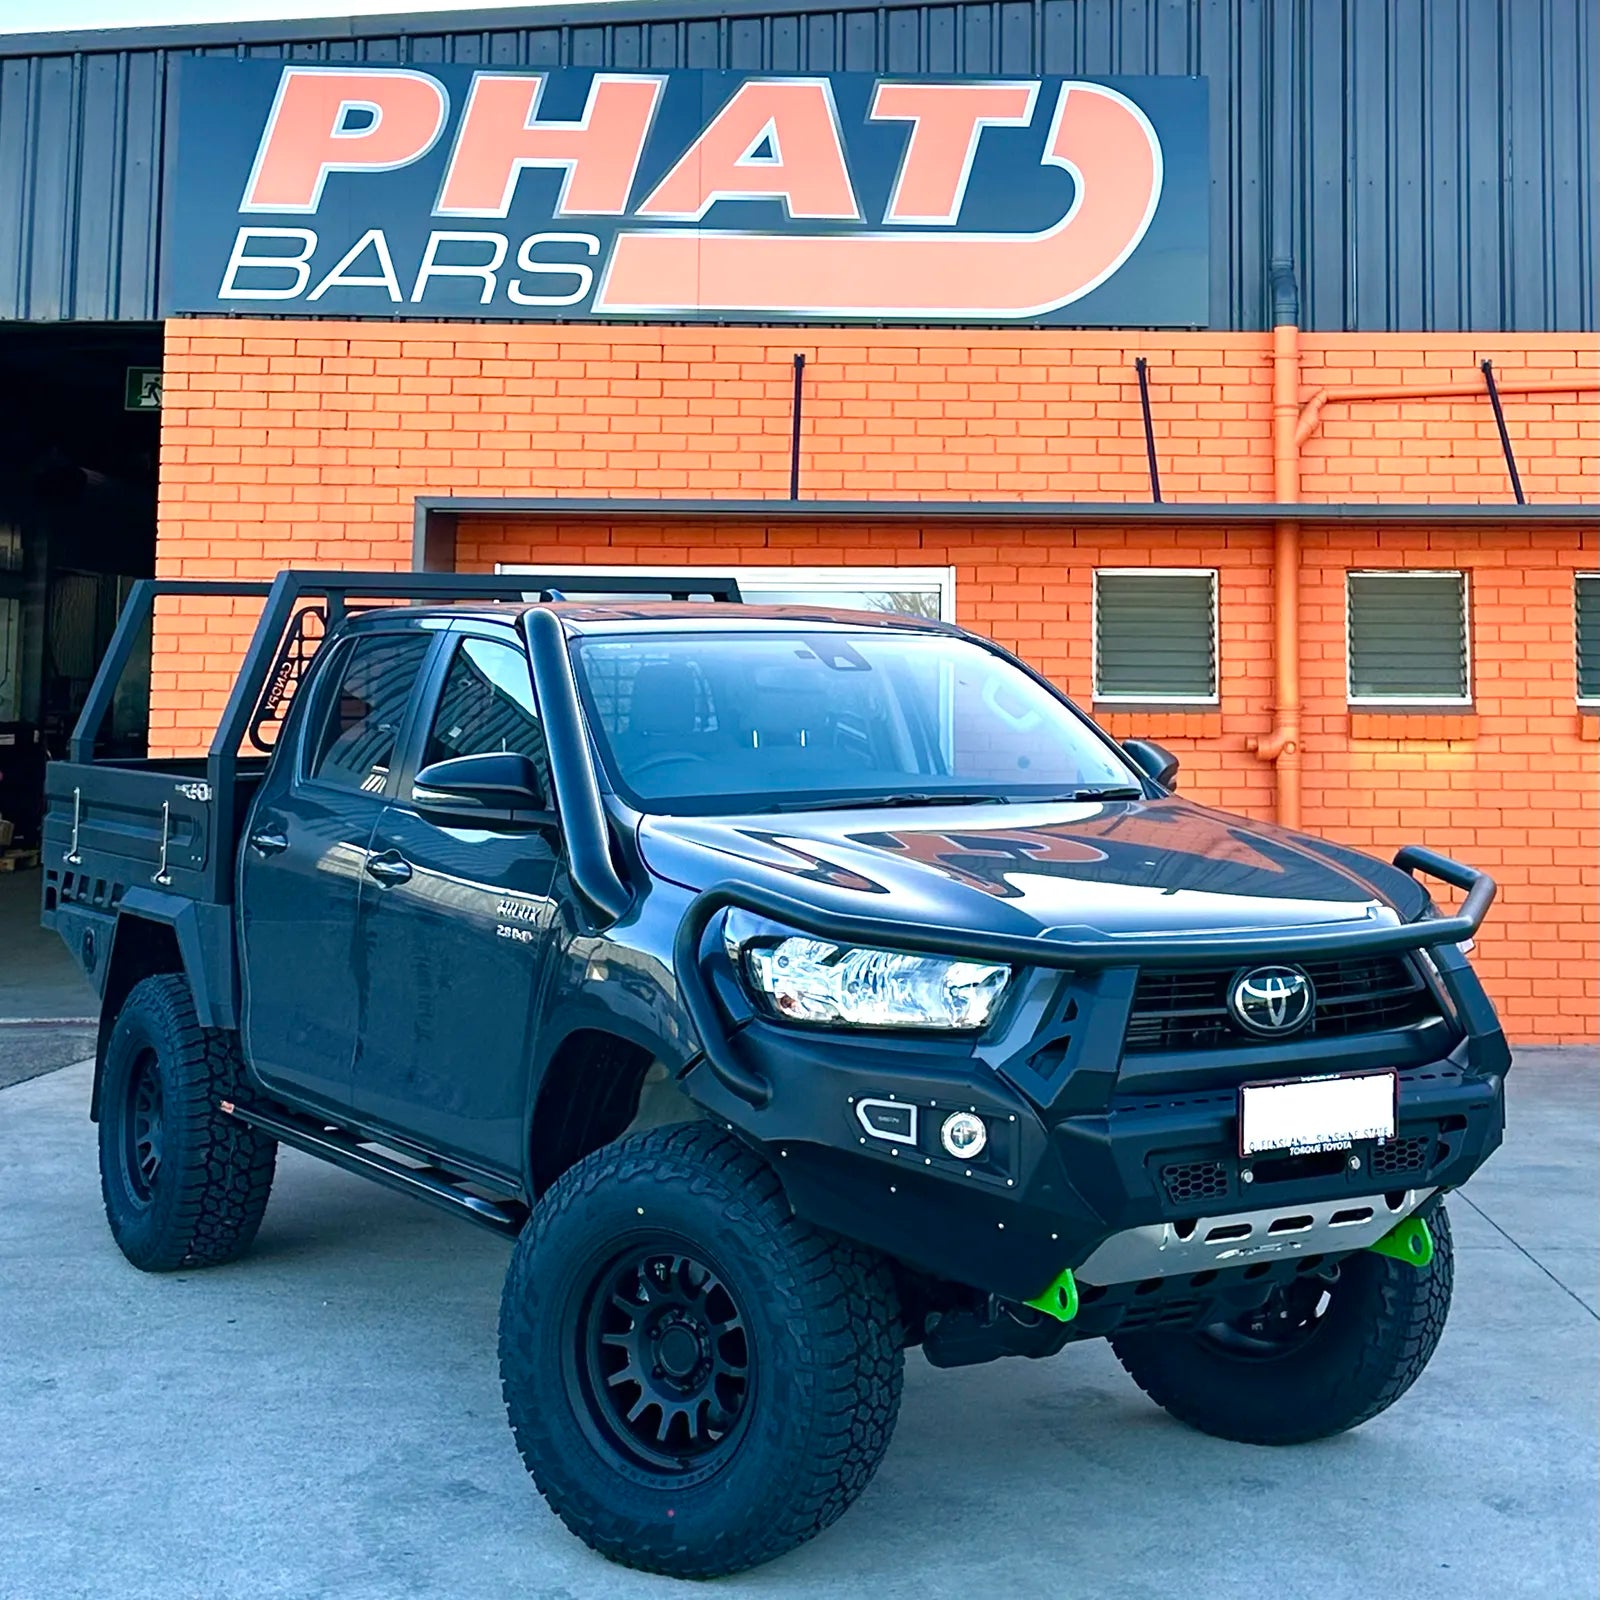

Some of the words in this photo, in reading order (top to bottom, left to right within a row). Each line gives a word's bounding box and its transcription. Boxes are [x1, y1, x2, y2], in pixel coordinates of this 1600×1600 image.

[238, 65, 1044, 228] PHAT
[218, 226, 602, 307] BARS
[1289, 1147, 1321, 1157] TORQUE
[1322, 1142, 1352, 1153] TOYOTA
